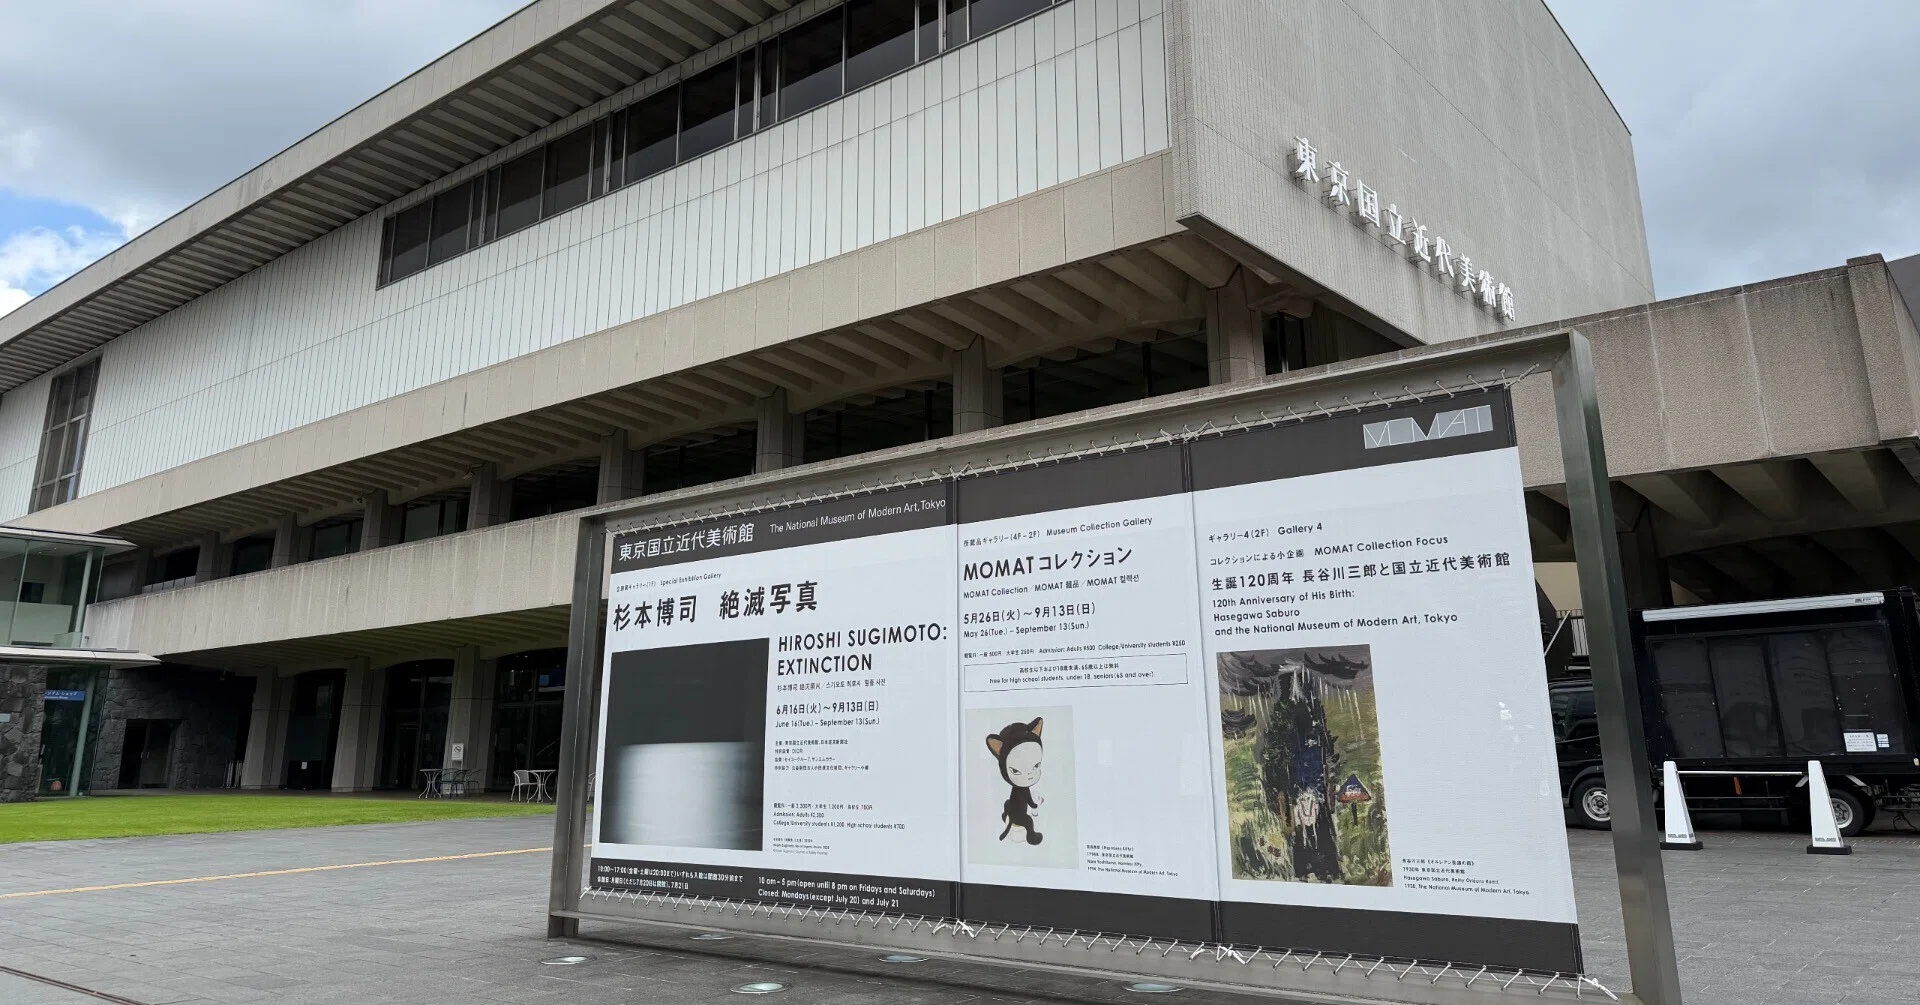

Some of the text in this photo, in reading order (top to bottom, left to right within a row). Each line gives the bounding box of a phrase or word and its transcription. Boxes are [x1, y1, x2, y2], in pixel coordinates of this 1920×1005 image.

[1294, 136, 1515, 321] 東京国立近代美術館
[770, 499, 946, 533] The National Museum of Modern Art, Tokyo
[1047, 518, 1153, 536] Museum Collection Gallery
[1278, 523, 1323, 535] Gallery 4
[618, 522, 755, 562] 東京国立近代美術館
[1315, 537, 1448, 556] MOMAT Collection Focus
[963, 546, 1132, 581] MOMATコレクション
[1211, 549, 1305, 566] コレクションによる小企画
[1212, 552, 1510, 591] 生誕120周年 長谷川三郎と国立近代美術館
[660, 579, 678, 587] Special
[964, 582, 1064, 599] MOMAT Collection MOMAT
[1087, 577, 1118, 587] MOMAT
[613, 580, 819, 632] 杉本博司 絶滅写真
[1213, 589, 1355, 608] 120th Anniversary of His Birth:
[1214, 609, 1300, 623] Hasegawa Saburo
[1215, 613, 1458, 636] and the National Museum of Modern Art, Tokyo
[778, 622, 947, 652] HIROSHI SUGIMOTO:
[964, 631, 979, 639] May
[1016, 625, 1057, 635] September
[777, 653, 872, 676] EXTINCTION
[820, 719, 854, 727] September
[758, 889, 779, 897] Closed:
[835, 895, 847, 905] July
[862, 898, 874, 906] and
[876, 898, 889, 908] July
[891, 899, 898, 907] 21
[817, 881, 830, 889] until
[832, 882, 836, 890] 8
[859, 884, 882, 895] Fridays
[899, 887, 935, 899] Saturdays)
